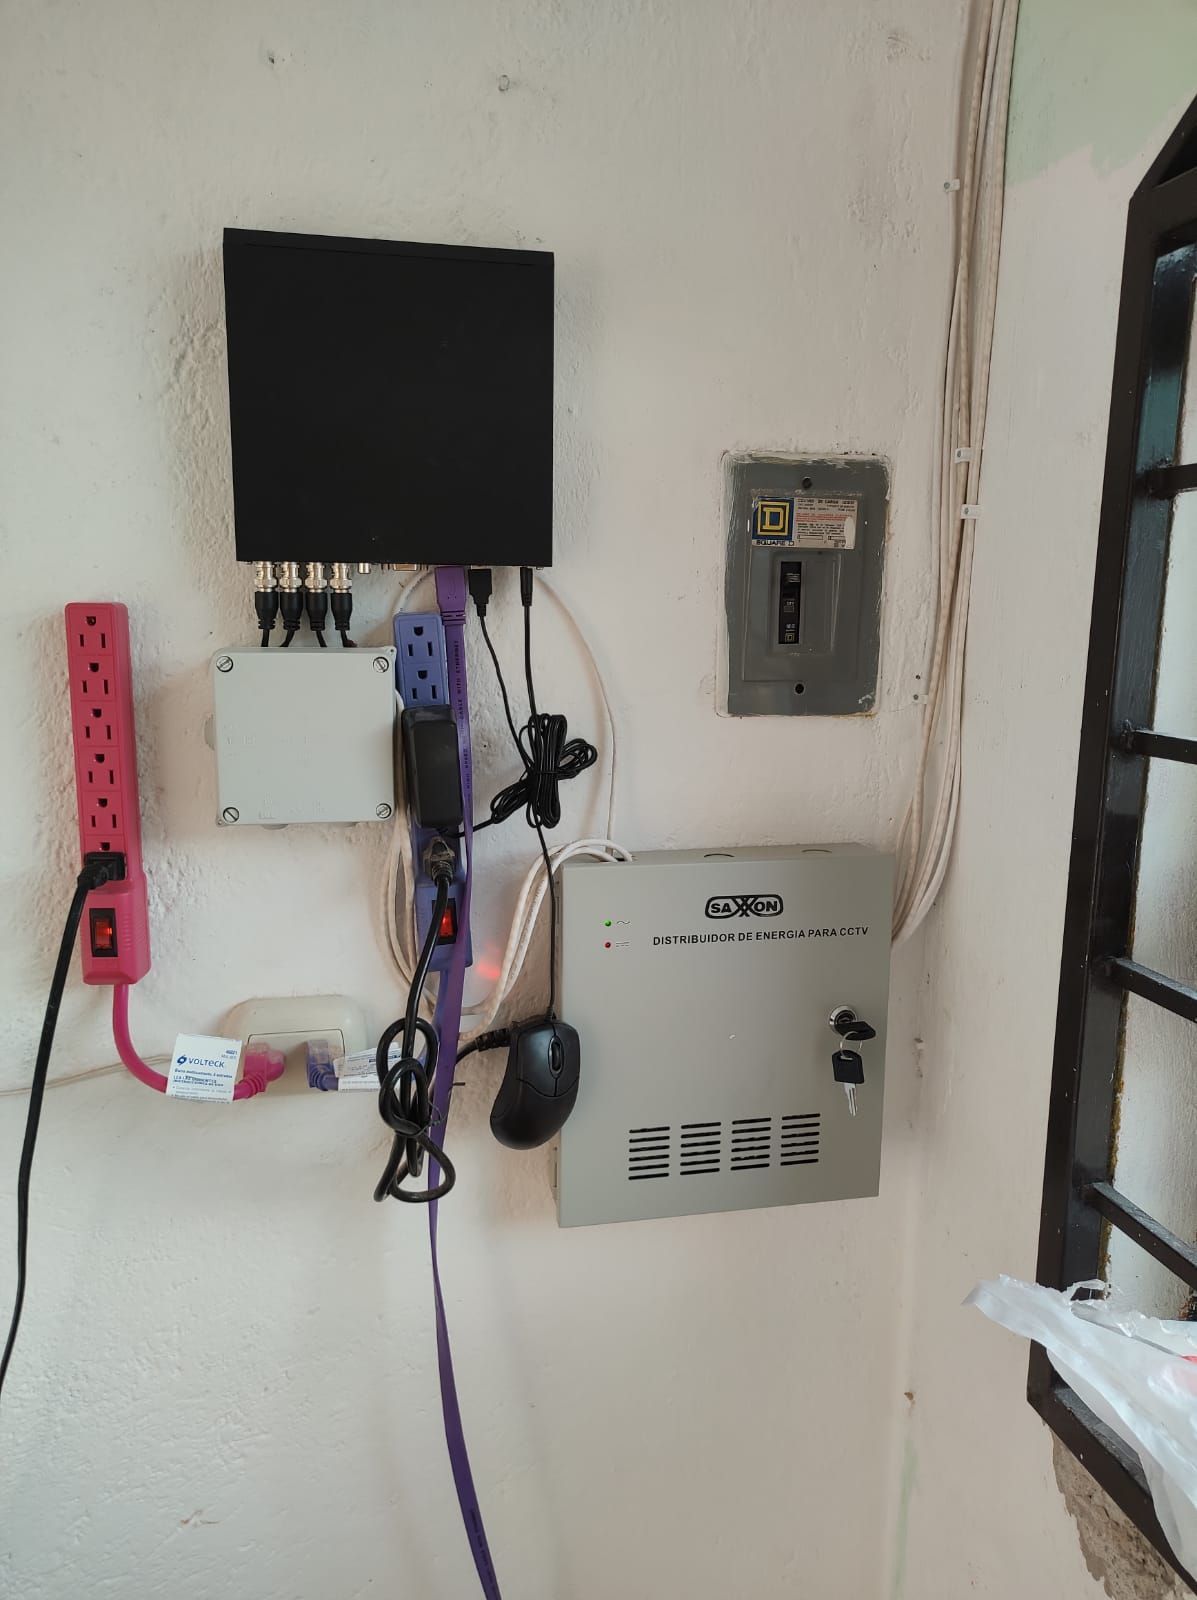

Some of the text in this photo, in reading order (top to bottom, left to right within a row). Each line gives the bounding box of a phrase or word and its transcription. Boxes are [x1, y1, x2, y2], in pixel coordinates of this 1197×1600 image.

[711, 897, 778, 917] SAXXON
[653, 926, 869, 946] DISTRIBUIDOR DE ENERGIA PARA CCTV
